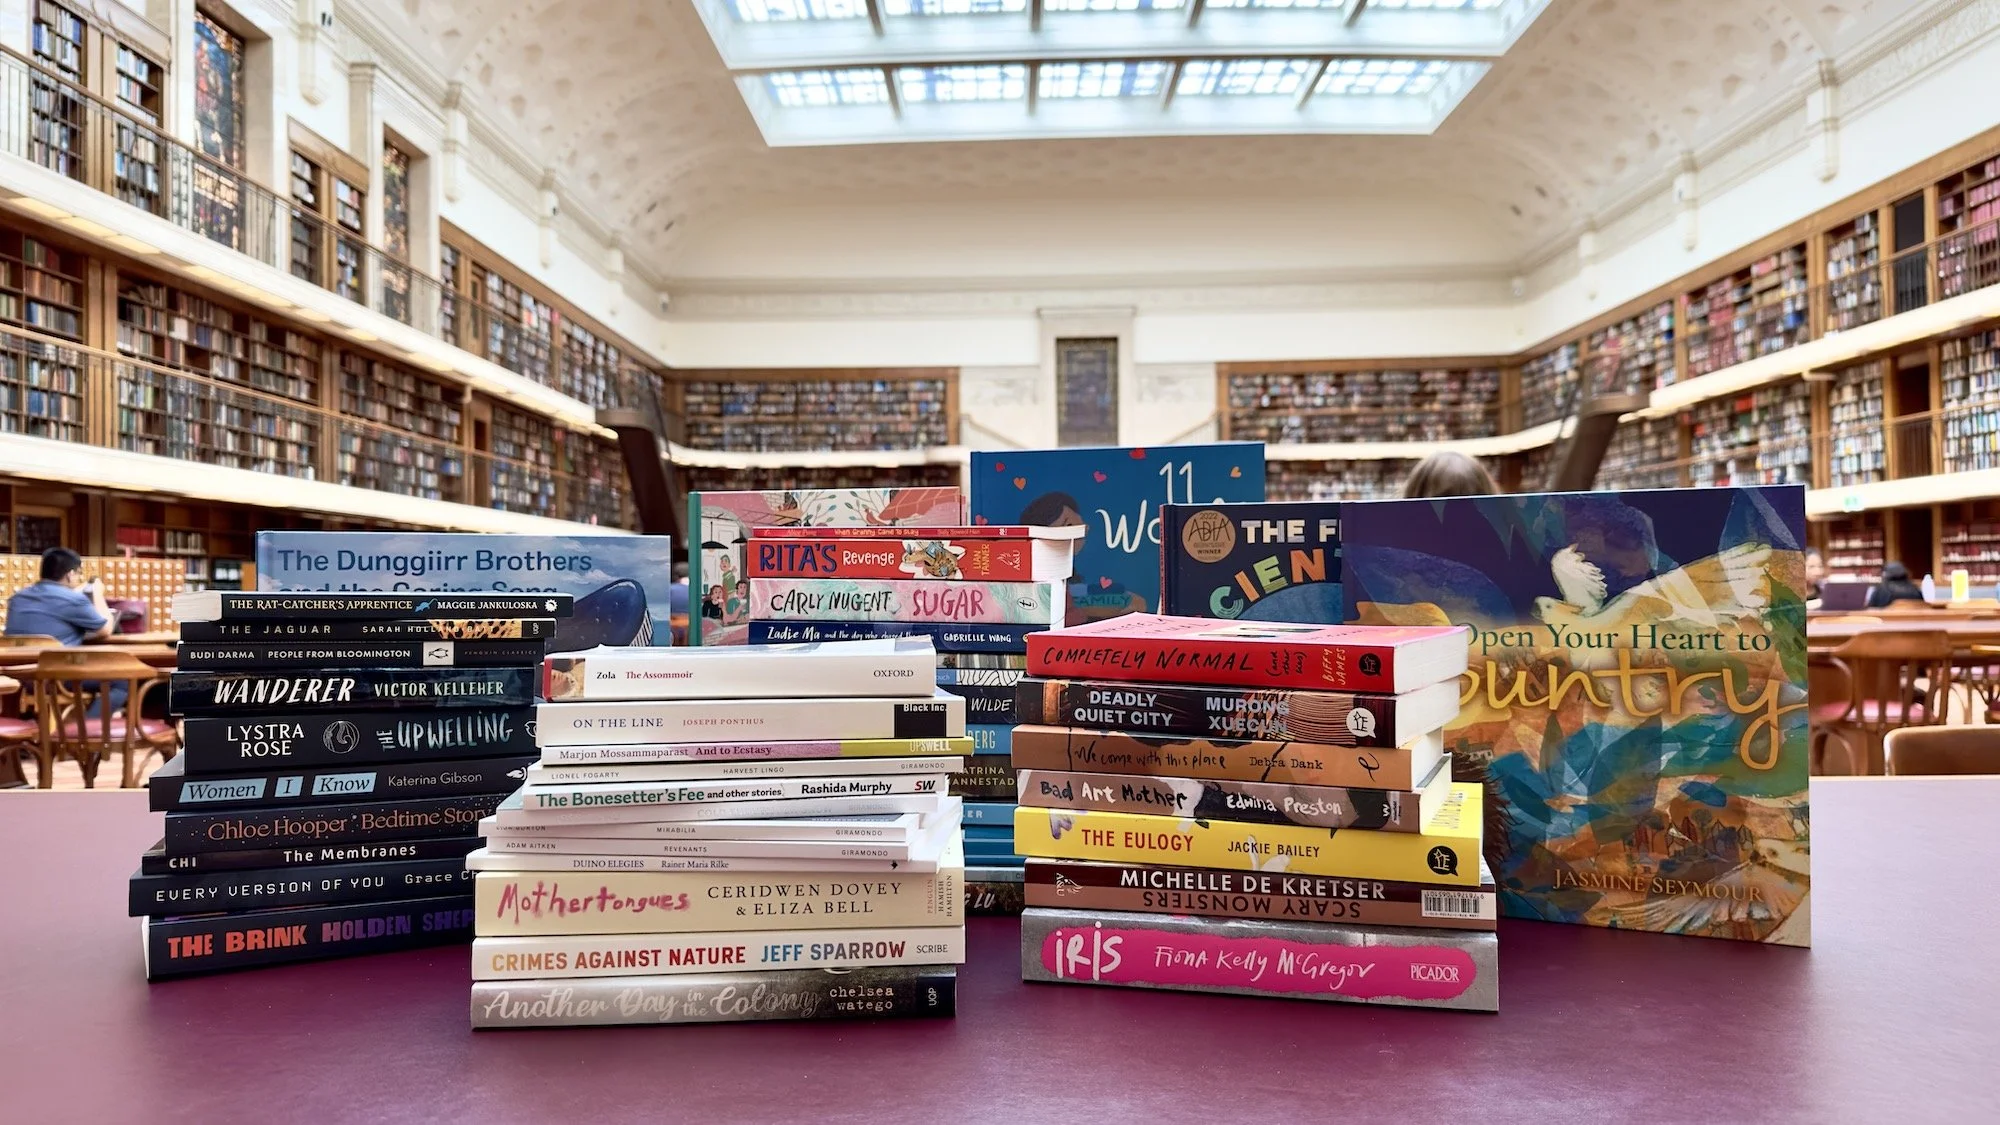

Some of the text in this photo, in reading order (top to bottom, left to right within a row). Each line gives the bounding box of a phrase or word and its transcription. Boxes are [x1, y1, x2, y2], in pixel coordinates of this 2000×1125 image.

[1160, 461, 1194, 504] 11
[1241, 520, 1305, 544] THE
[278, 550, 592, 576] The Dunggiirr Brothers
[760, 544, 895, 573] RITA'S Revenge
[230, 600, 412, 610] THE RAT-CATCHER'S APPRENTICE
[478, 602, 538, 610] JANKULOSKA
[828, 591, 892, 612] NUGENT
[912, 589, 985, 620] SUGAR
[220, 625, 332, 634] THE JAGUAR
[362, 626, 400, 634] SARAH
[767, 626, 820, 640] Zadie Ma
[944, 633, 985, 642] GABRIELLE
[989, 634, 1012, 642] WANG
[1548, 624, 1619, 649] Your
[1630, 624, 1724, 650] Heart
[1738, 629, 1771, 652] to
[190, 651, 254, 659] BUDI DARMA
[268, 650, 410, 658] PEOPLE FROM BLOOMINGTON
[1044, 646, 1254, 672] COMPLETELY NORMAL
[596, 672, 616, 680] Zola
[626, 671, 642, 679] The
[873, 670, 914, 678] OXFORD
[214, 678, 355, 704] WANDERER
[374, 682, 504, 698] VICTOR KELLEHER
[1090, 690, 1158, 708] DEADLY
[904, 704, 929, 712] Black
[971, 698, 1012, 712] WILDE
[573, 718, 664, 728] ON THE LINE
[683, 718, 717, 726] JOSEPH
[1074, 708, 1173, 727] QUIET CITY
[227, 724, 304, 742] LYSTRA
[240, 740, 292, 758] ROSE
[560, 750, 597, 760] Marjon
[696, 746, 772, 756] And to Ecstasy
[1136, 748, 1226, 770] with this place
[1249, 756, 1324, 770] Debra Dank
[188, 776, 370, 800] Women I Know
[388, 772, 483, 787] Katerina Gibson
[801, 782, 892, 795] Rashida Murphy
[536, 788, 782, 808] The Bonesetter's Fee and other stories
[1040, 781, 1188, 810] Bad Art Mother
[1226, 792, 1342, 816] Edwina Preston
[361, 810, 442, 830] Bedtime
[208, 818, 348, 841] Chloe Hooper
[1082, 829, 1194, 852] THE EULOGY
[1228, 841, 1320, 858] JACKIE BAILEY
[169, 857, 197, 868] CHI
[284, 846, 416, 862] The Membranes
[573, 860, 644, 868] DUINO ELEGIES
[661, 860, 730, 868] Rainer Maria Rilke
[404, 874, 452, 884] Grace
[1056, 872, 1065, 896] A&U
[1120, 870, 1386, 900] MICHELLE DE KRETSER
[1553, 869, 1765, 903] JASMINE SEYMOUR
[156, 876, 384, 902] EVERY VERSION OF YOU
[708, 882, 902, 899] CERIDWEN DOVEY
[498, 880, 691, 926] Mothertongues
[736, 901, 874, 916] & ELIZA BELL
[1143, 891, 1362, 918] SCARY MONSTERS
[322, 915, 412, 942] HOLDEN
[168, 924, 308, 959] THE BRINK
[916, 944, 948, 954] SCRIBE
[492, 946, 746, 972] CRIMES AGAINST NATURE
[760, 941, 906, 962] JEFF SPARROW
[1216, 950, 1268, 982] Kelly
[1276, 948, 1376, 990] McGregor
[1410, 964, 1460, 982] PICADOR
[688, 990, 704, 1001] in
[710, 984, 820, 1017] Colony
[830, 986, 894, 998] chelsea
[484, 988, 680, 1020] Another Day
[836, 1000, 894, 1012] watego
